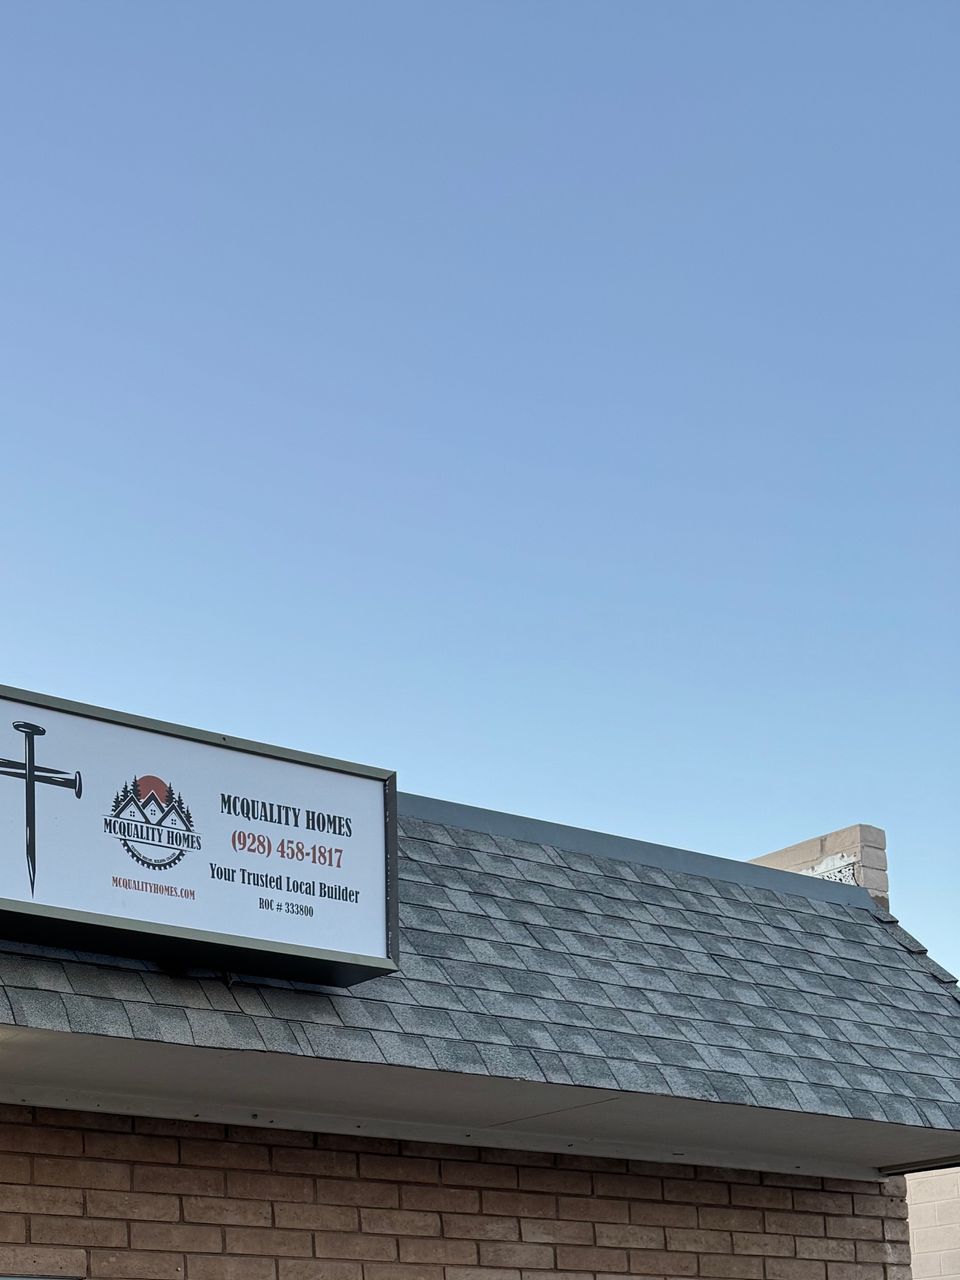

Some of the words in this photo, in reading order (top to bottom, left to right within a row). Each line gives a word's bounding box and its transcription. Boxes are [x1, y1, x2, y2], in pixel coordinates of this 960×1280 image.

[220, 793, 301, 828] MCQUALITY
[305, 809, 352, 838] HOMES
[103, 818, 163, 843] MCQUALITY
[167, 830, 202, 850] HOMES
[231, 830, 272, 858] (928)
[276, 838, 344, 868] 458-1817
[112, 876, 195, 900] MCQUALITYHOMES.COM
[209, 863, 236, 883] Your
[240, 868, 282, 891] Trusted
[286, 876, 315, 897] Local
[319, 882, 360, 904] Builder
[259, 897, 274, 911] ROC
[276, 902, 283, 912] #
[284, 902, 314, 918] 333800
